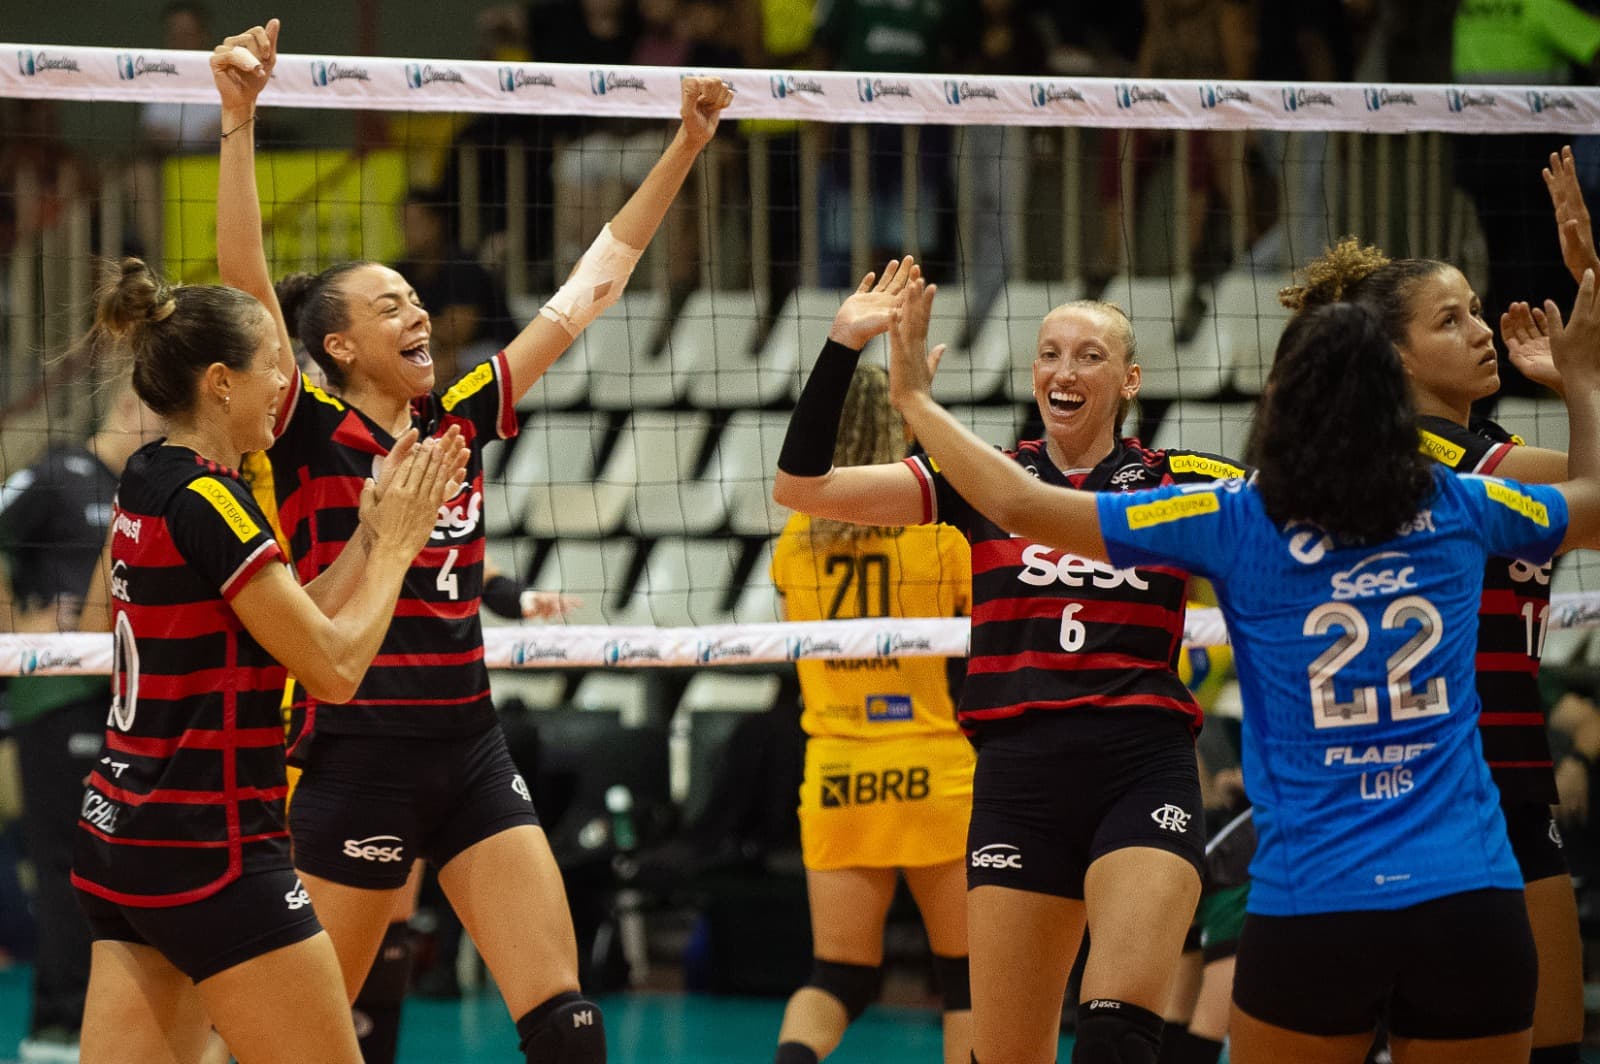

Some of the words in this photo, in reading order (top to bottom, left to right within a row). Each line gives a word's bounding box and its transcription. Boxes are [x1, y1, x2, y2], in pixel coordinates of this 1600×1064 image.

[436, 549, 459, 600] 4
[824, 553, 891, 620] 20
[1058, 602, 1087, 653] 6
[1302, 595, 1450, 730] 22
[855, 767, 931, 804] BRB
